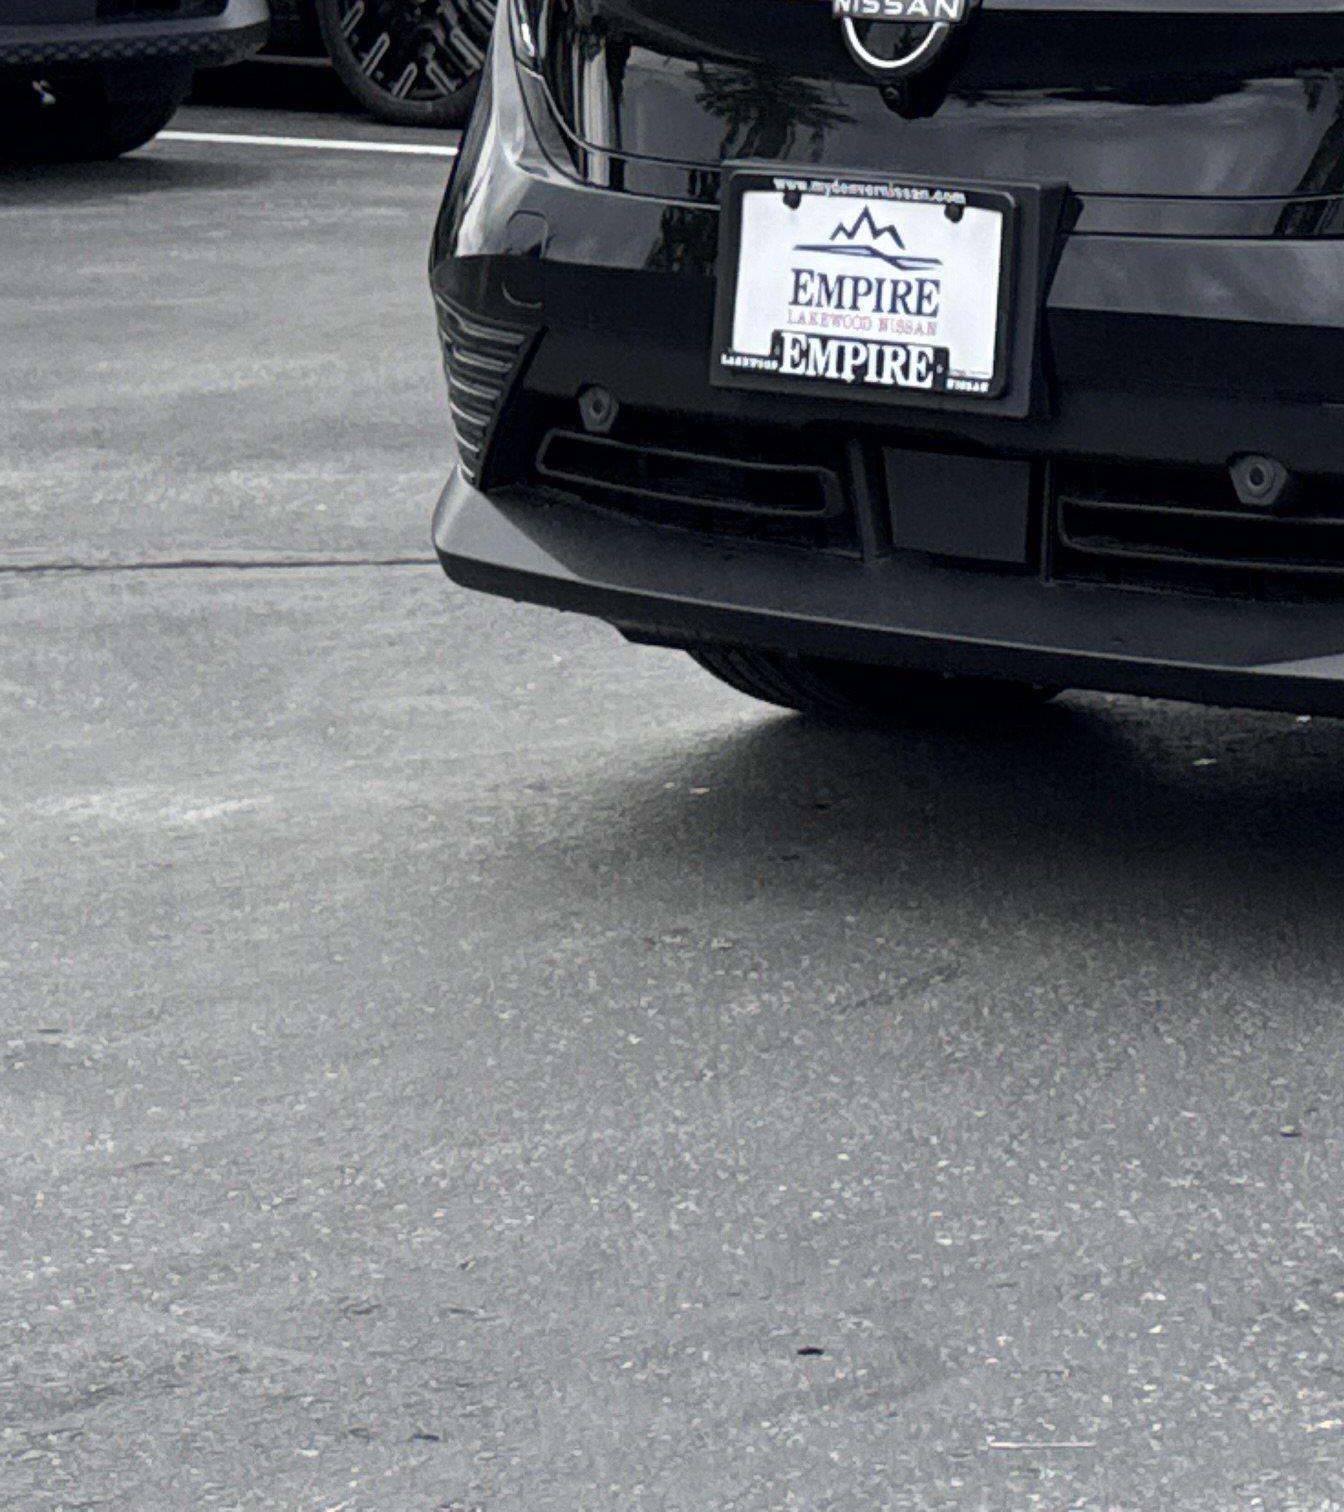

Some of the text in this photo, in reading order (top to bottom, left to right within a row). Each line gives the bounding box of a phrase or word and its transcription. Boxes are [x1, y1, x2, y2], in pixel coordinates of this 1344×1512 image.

[788, 267, 942, 319] EMPIRE
[786, 307, 938, 337] LAKEWOOD NISSAN
[778, 331, 935, 389] EMPIRE
